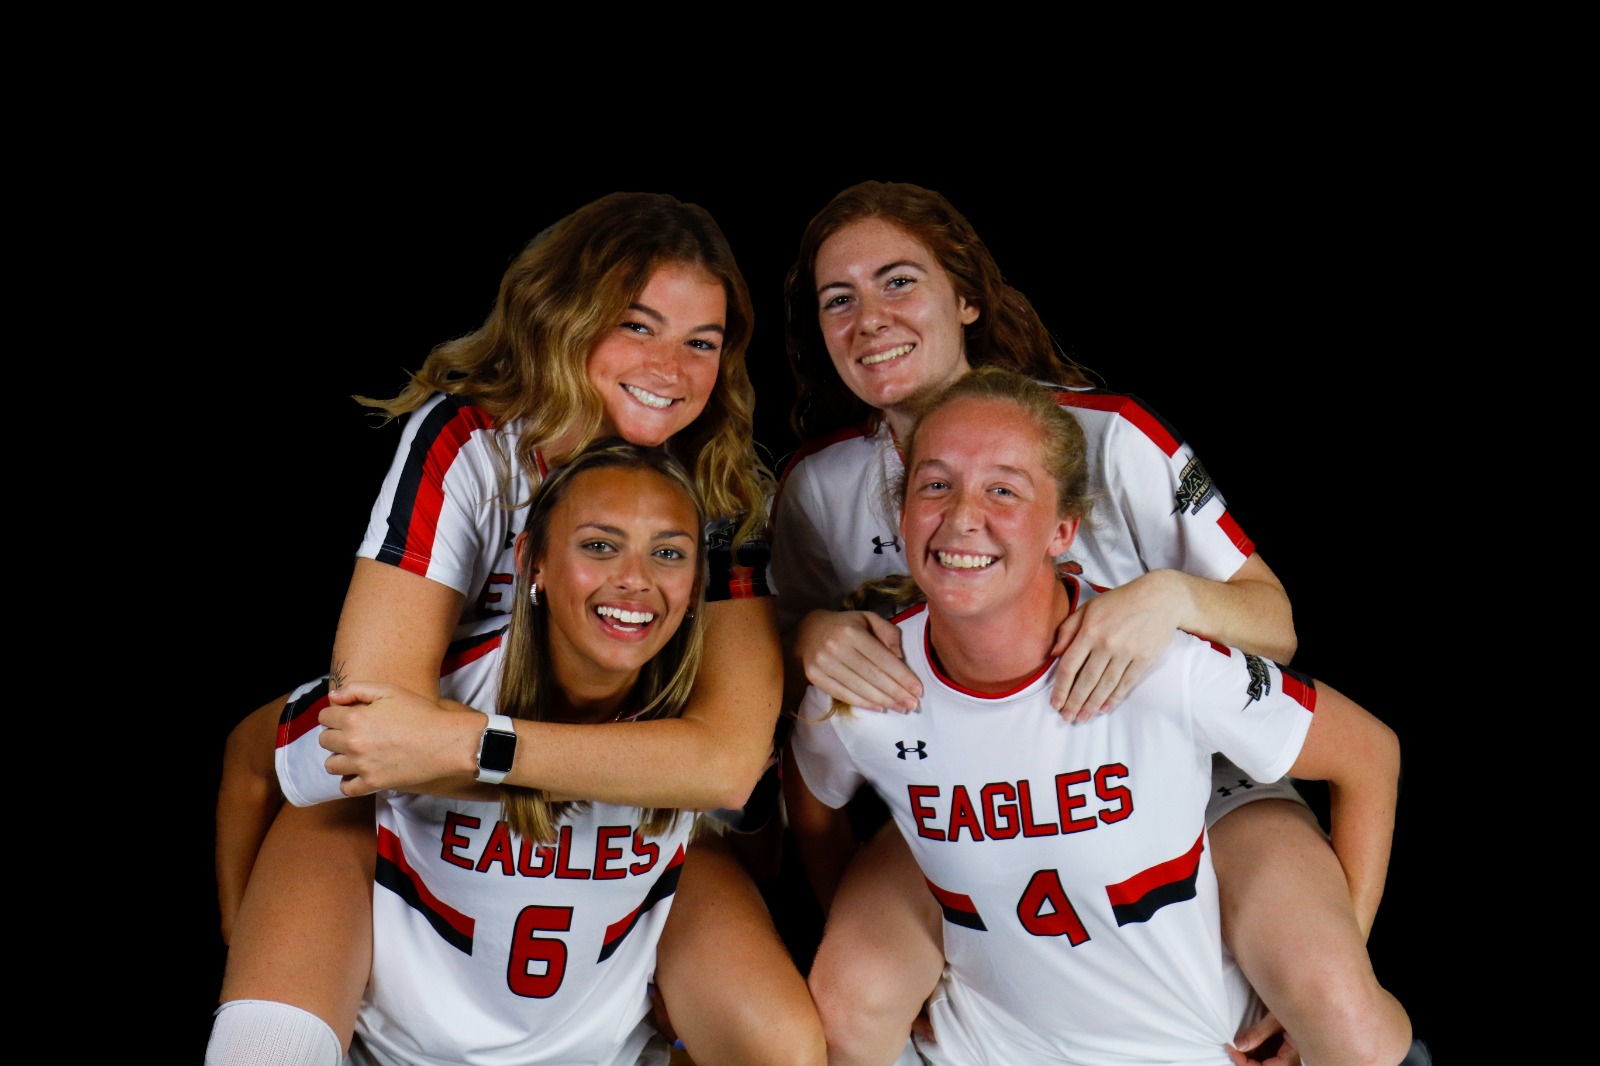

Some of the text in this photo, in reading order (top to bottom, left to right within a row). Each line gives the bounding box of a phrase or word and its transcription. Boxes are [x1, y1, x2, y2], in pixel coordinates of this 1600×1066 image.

[907, 762, 1134, 842] EAGLES
[440, 811, 660, 880] EAGLES
[1016, 869, 1092, 947] 4
[507, 905, 574, 999] 6
